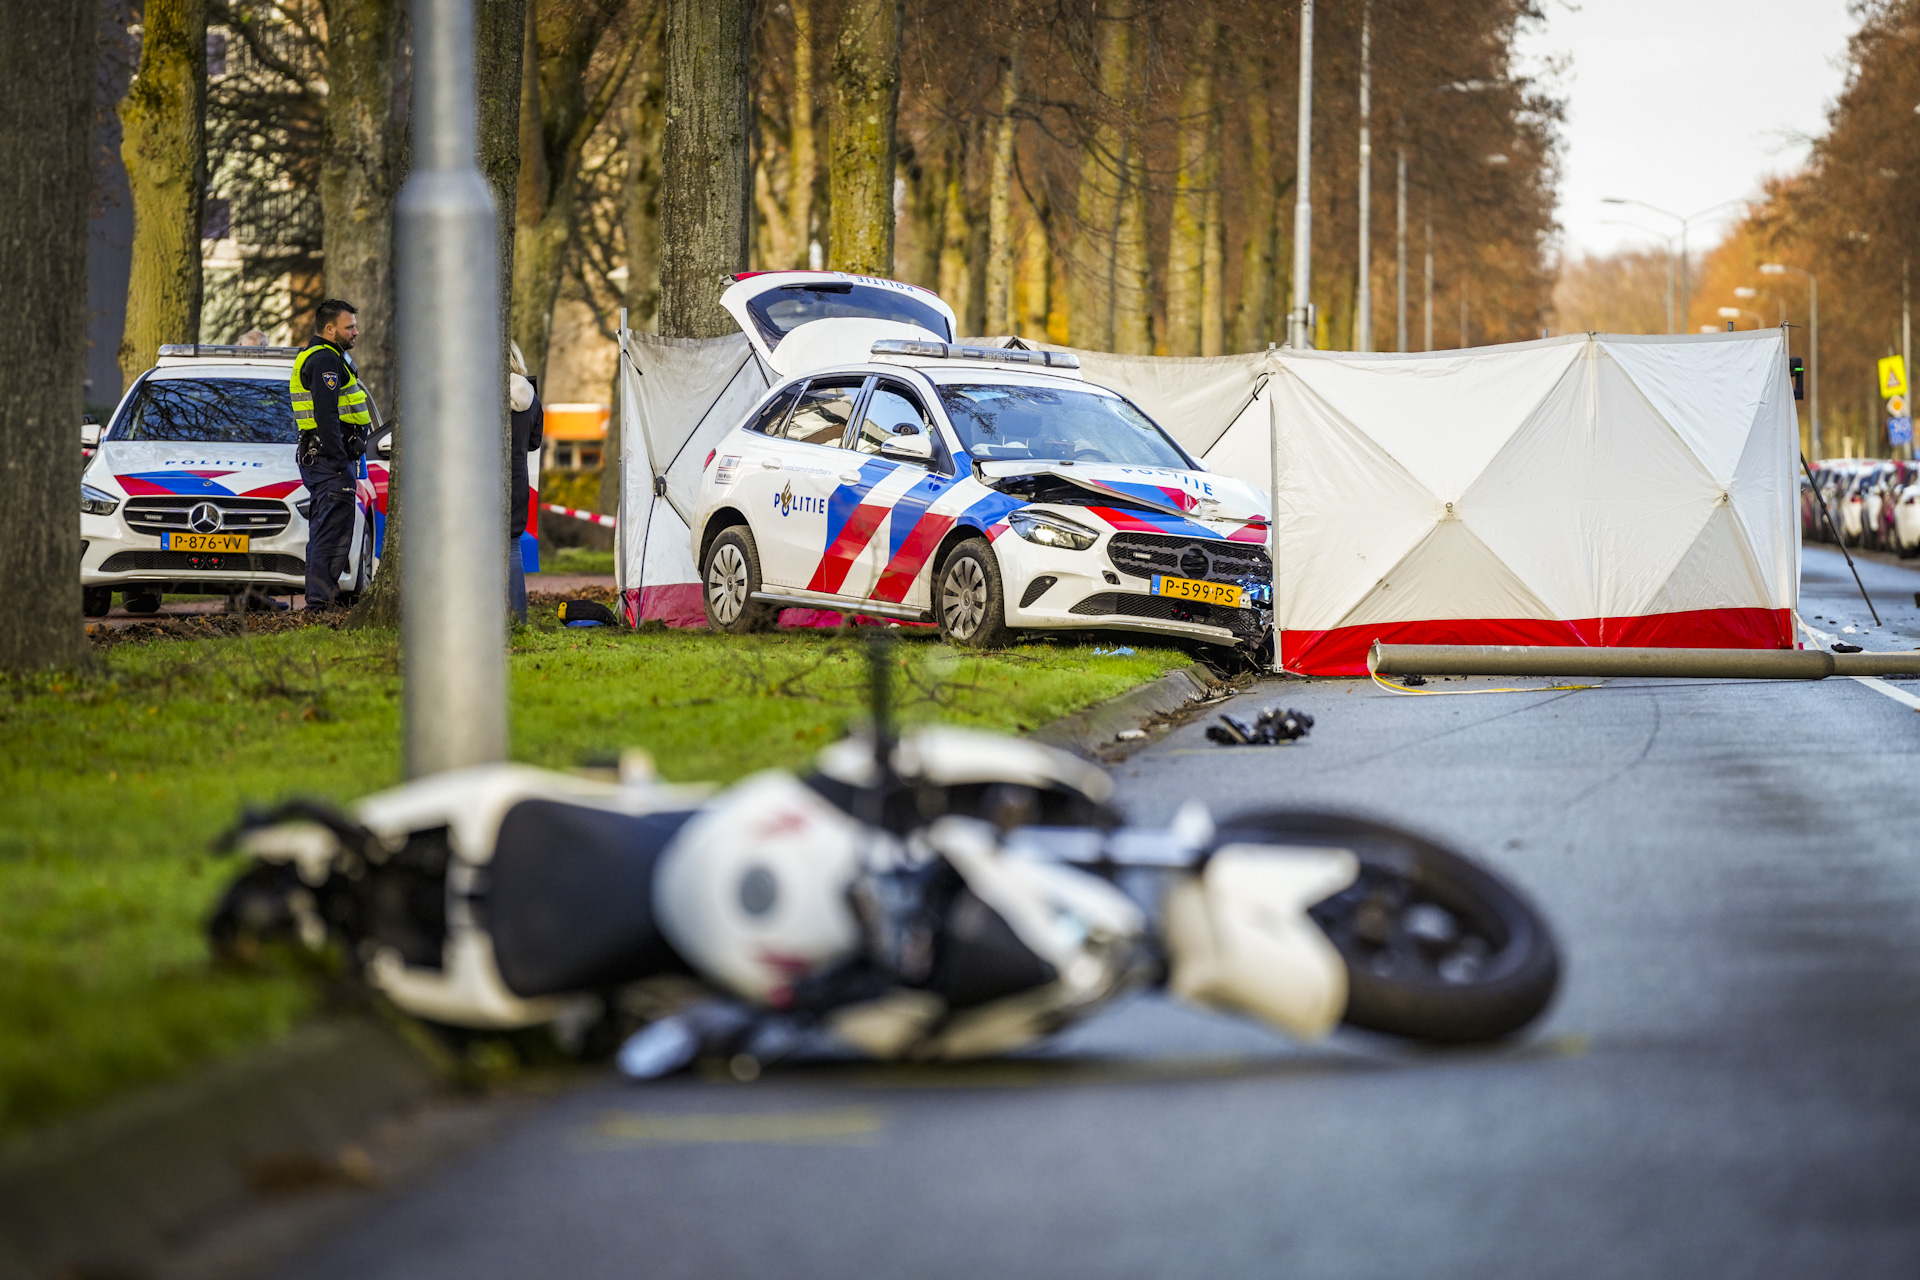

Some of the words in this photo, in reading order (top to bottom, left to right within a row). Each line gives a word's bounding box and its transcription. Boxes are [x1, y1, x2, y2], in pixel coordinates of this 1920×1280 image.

[856, 275, 914, 293] POLITIE
[165, 460, 263, 468] POLITIE
[774, 492, 825, 517] POLITIE
[175, 535, 242, 550] P-876-VV
